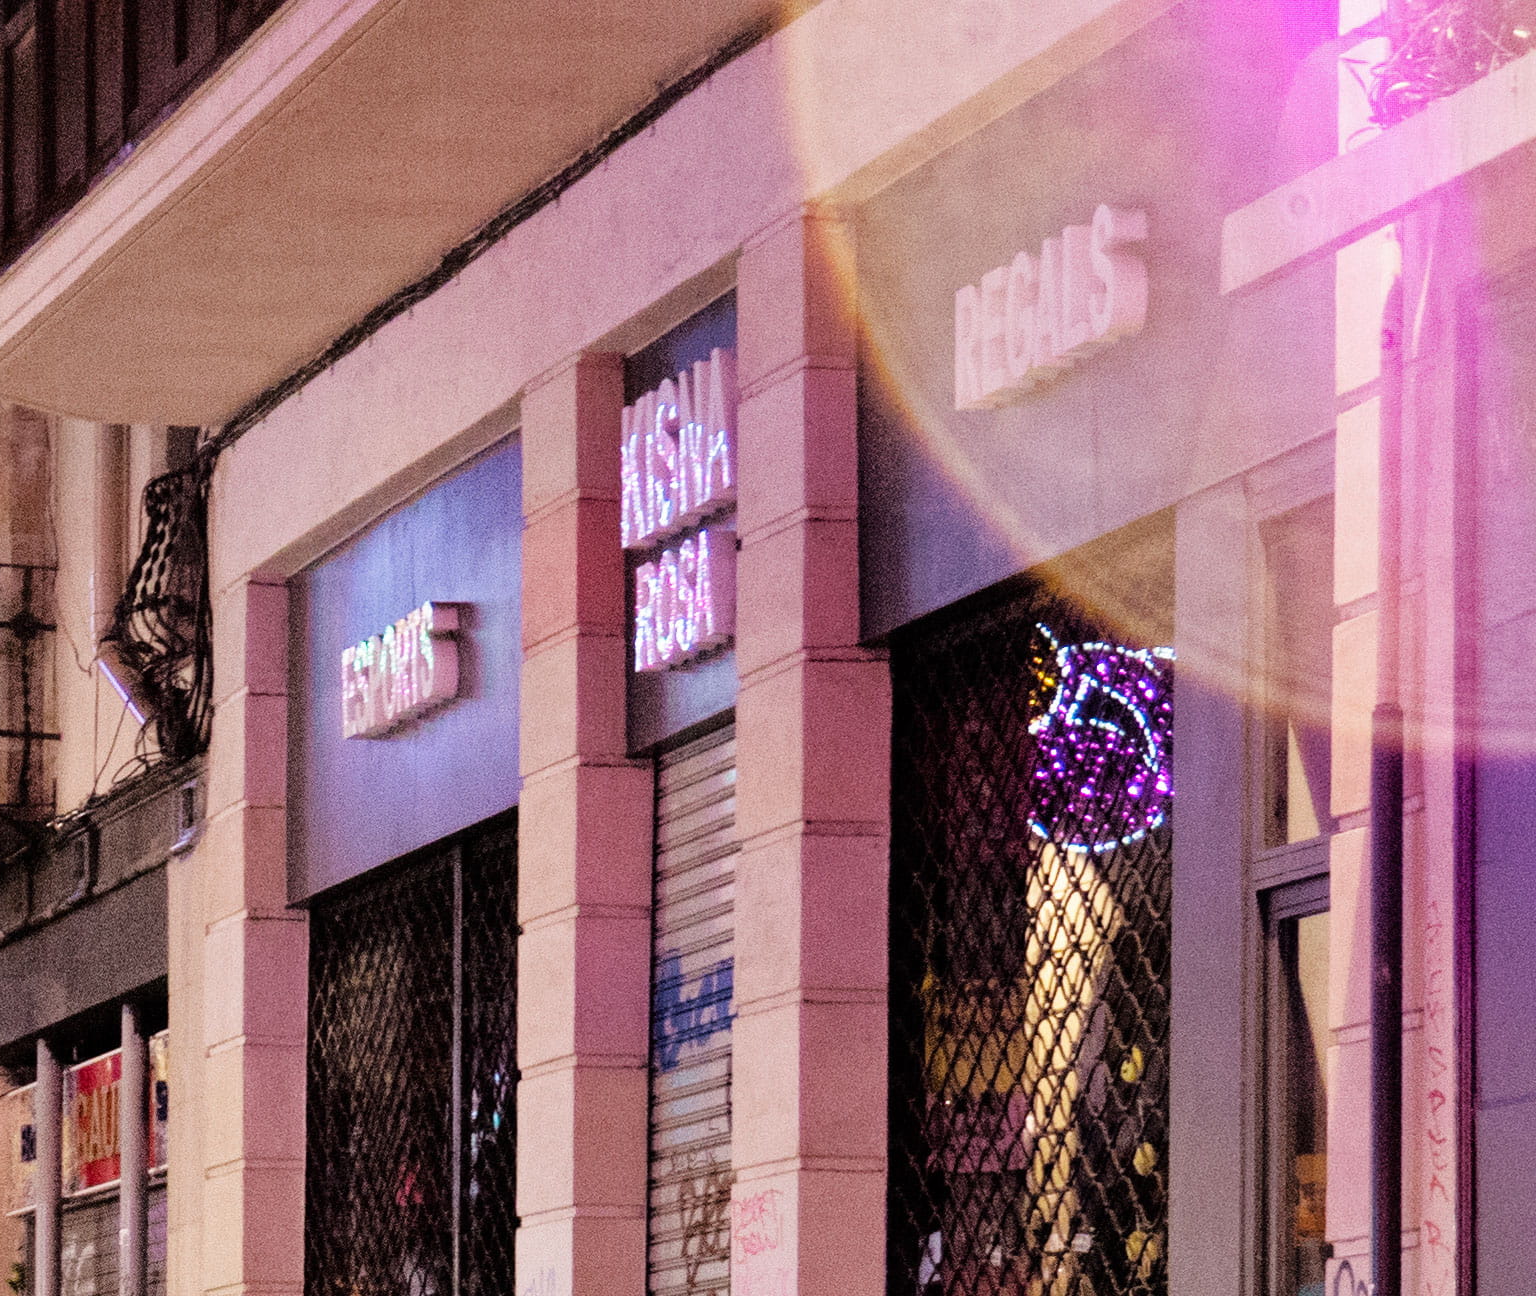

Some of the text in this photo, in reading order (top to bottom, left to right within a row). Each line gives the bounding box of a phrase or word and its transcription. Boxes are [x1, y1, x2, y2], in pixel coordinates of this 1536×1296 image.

[954, 203, 1118, 411] REGALS
[341, 600, 435, 740] ESPORTS
[634, 529, 716, 673] ROSA
